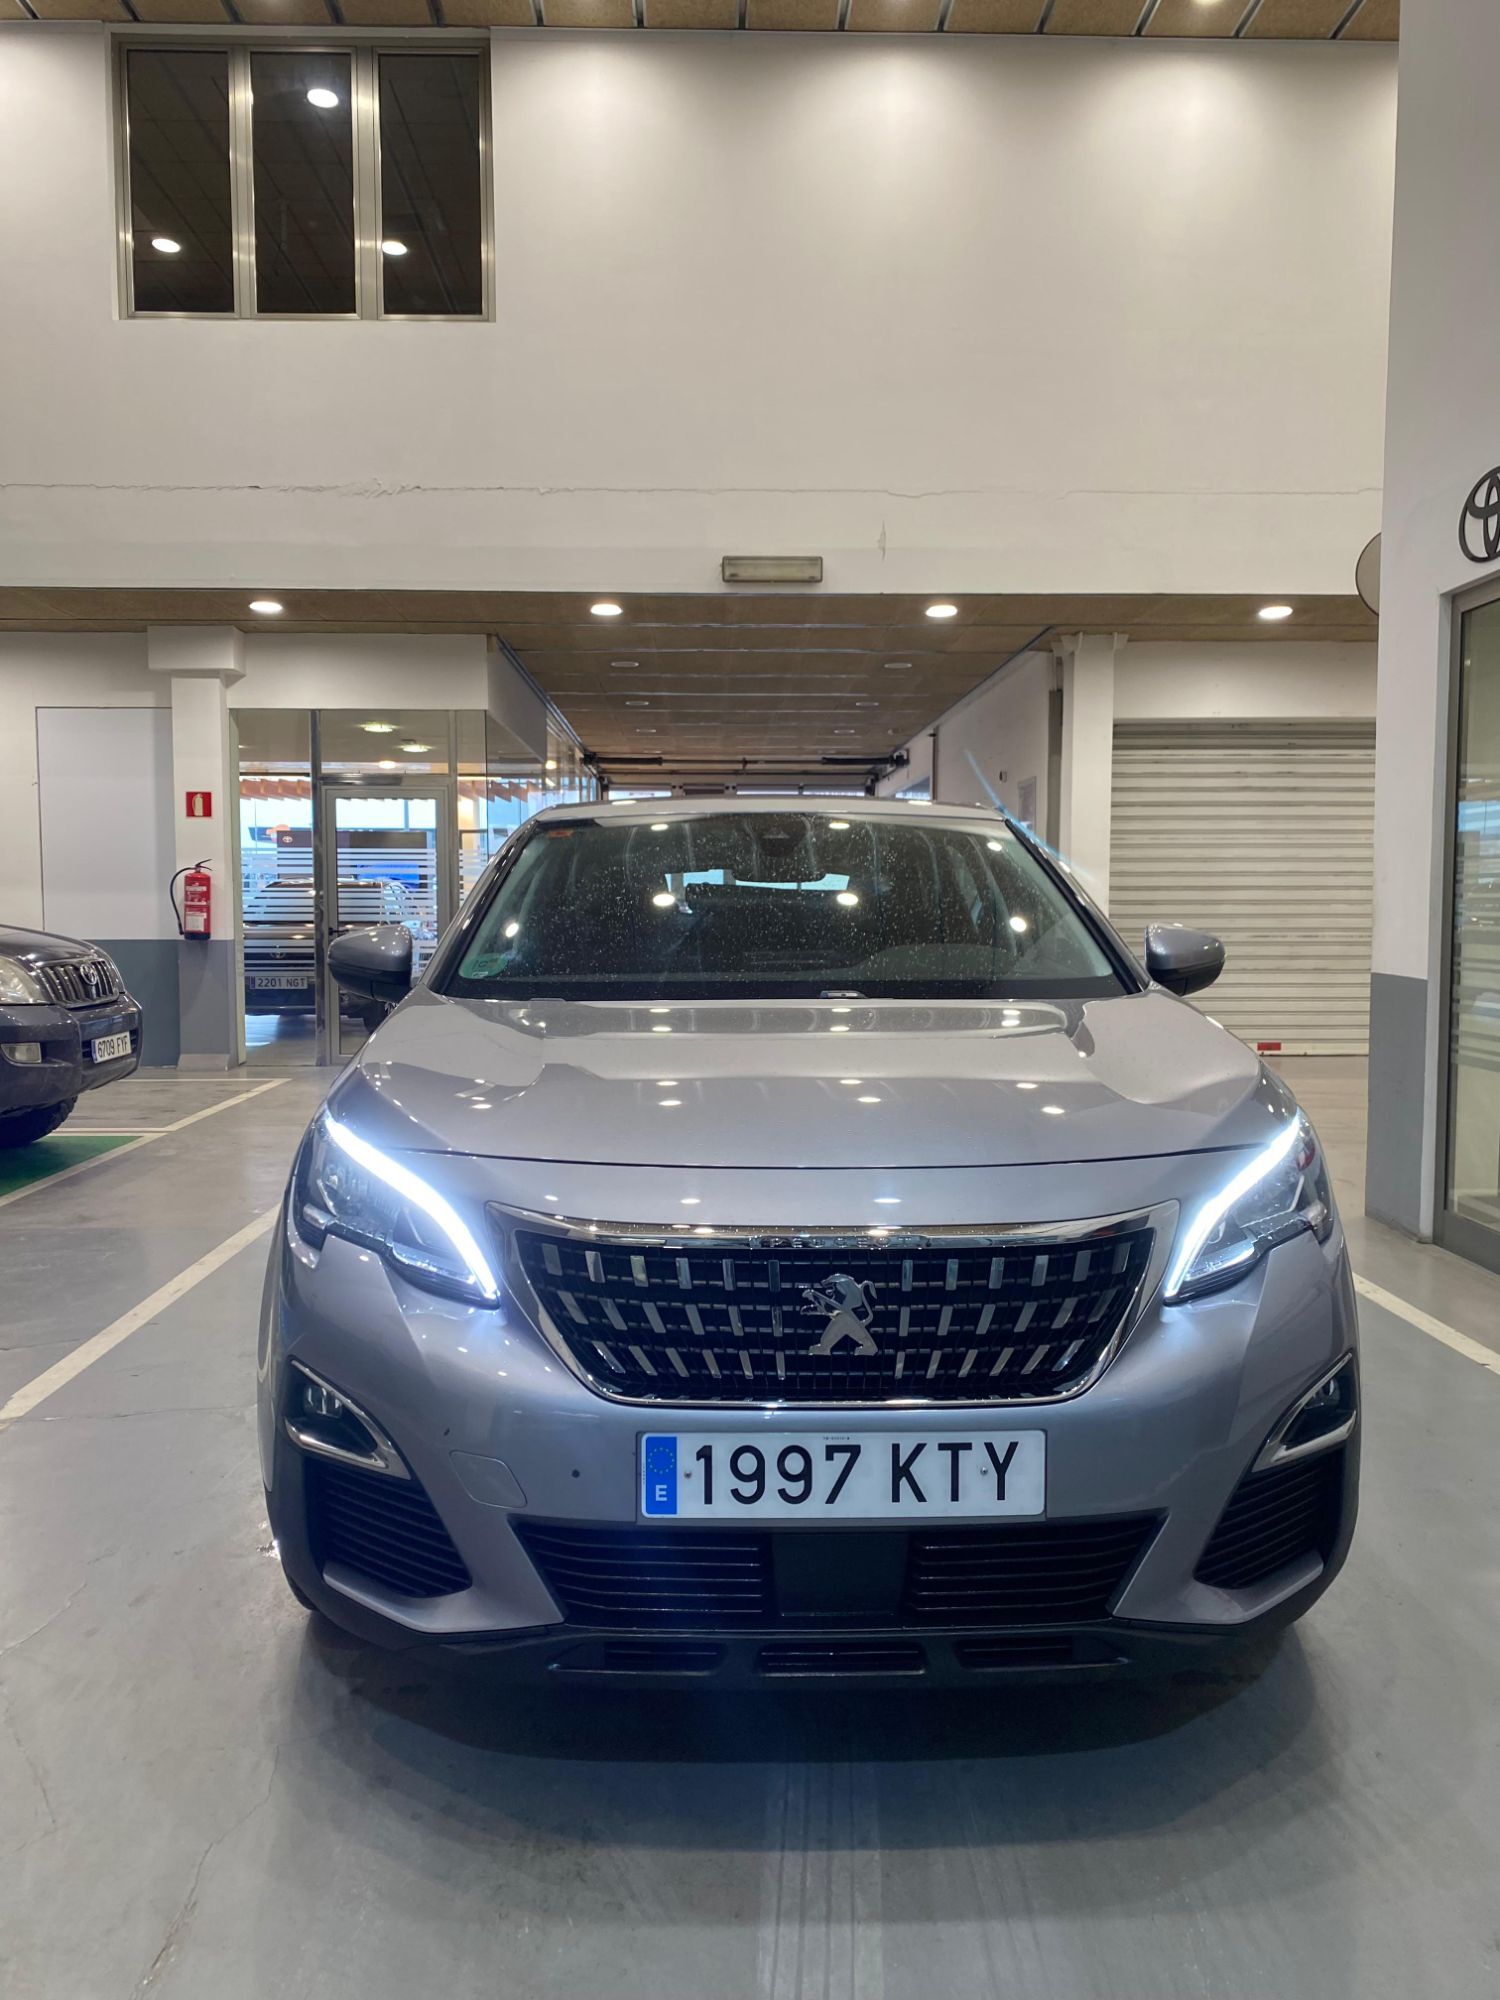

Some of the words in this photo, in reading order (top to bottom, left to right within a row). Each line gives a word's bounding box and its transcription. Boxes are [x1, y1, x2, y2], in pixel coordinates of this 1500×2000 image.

[257, 977, 282, 988] 2201
[286, 977, 305, 988] NGT
[97, 1039, 115, 1058] 6709
[770, 1237, 913, 1249] PEUGEOT
[695, 1444, 862, 1505] 1997
[891, 1441, 1019, 1503] KTY
[655, 1484, 668, 1501] E
